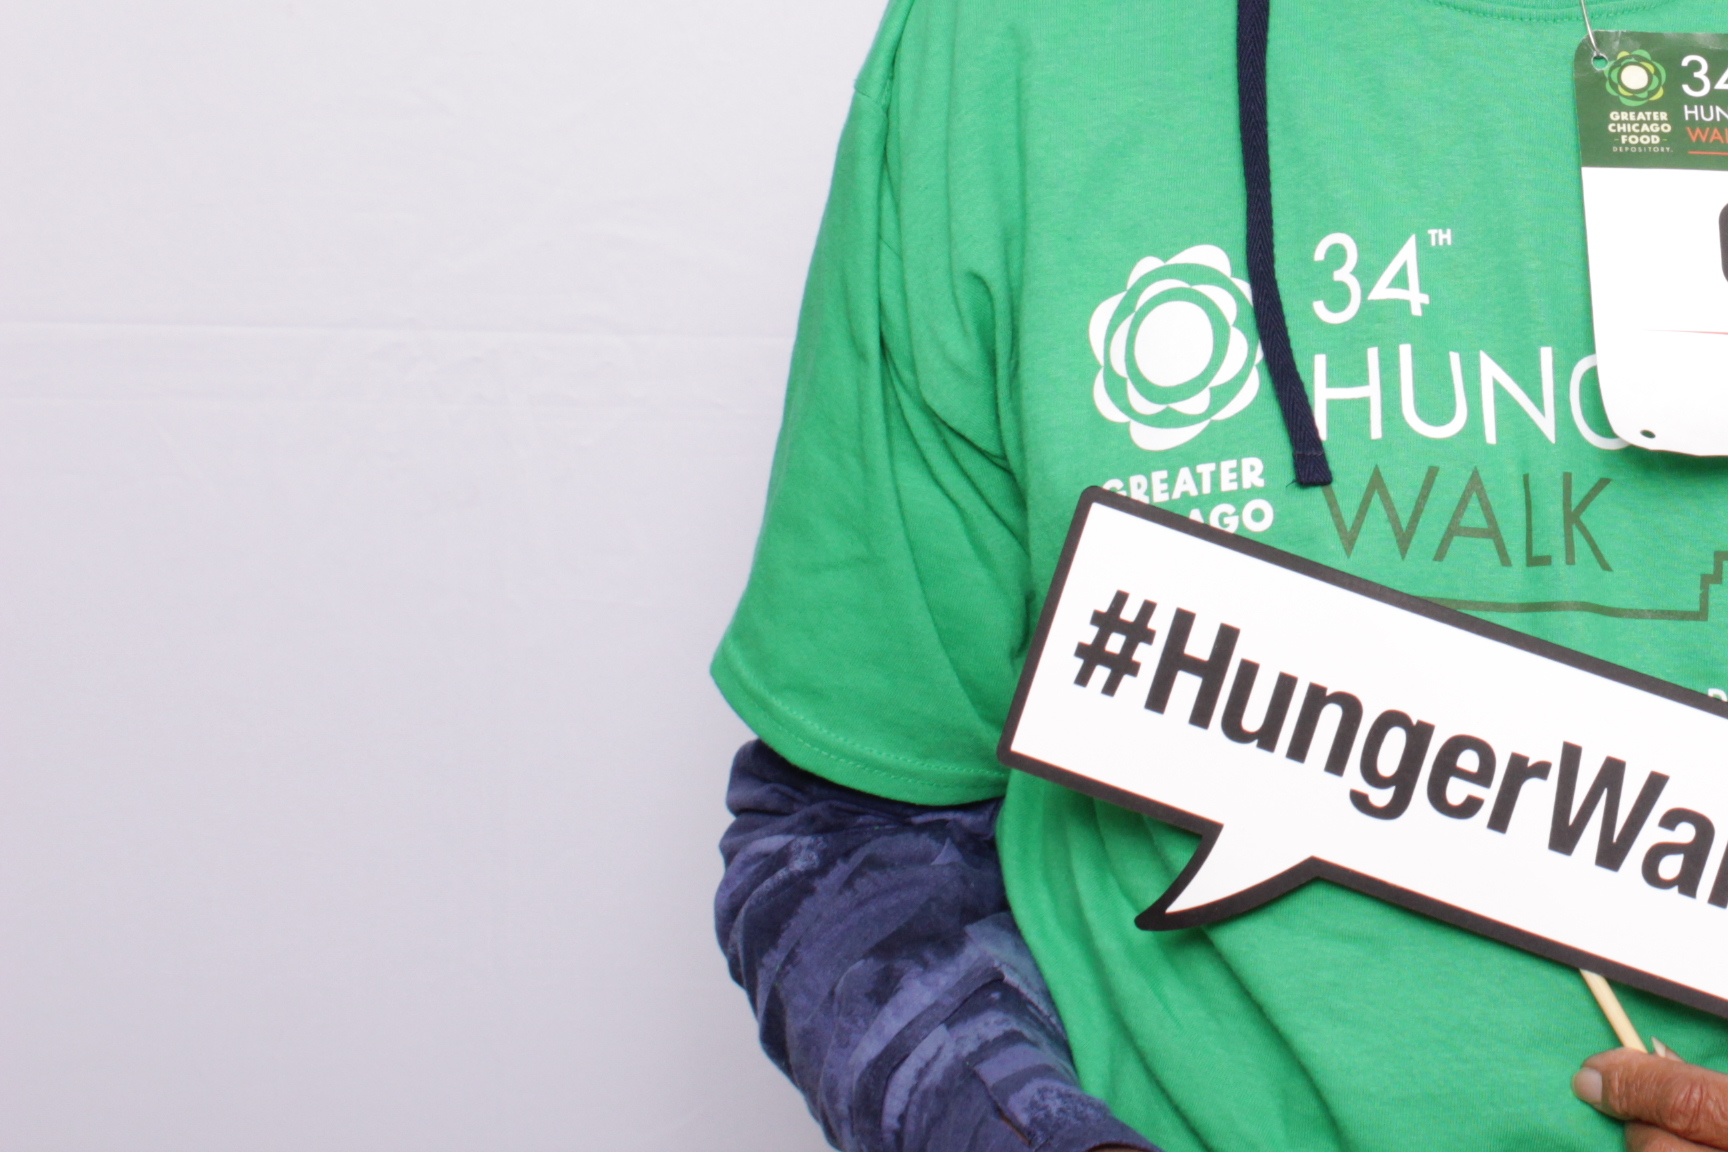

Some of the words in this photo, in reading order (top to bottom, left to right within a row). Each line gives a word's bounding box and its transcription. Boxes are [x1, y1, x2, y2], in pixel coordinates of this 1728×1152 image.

[1609, 110, 1669, 121] GREATER
[1607, 122, 1672, 133] CHICAGO
[1620, 134, 1661, 144] FOOD
[1321, 464, 1613, 573] WALK
